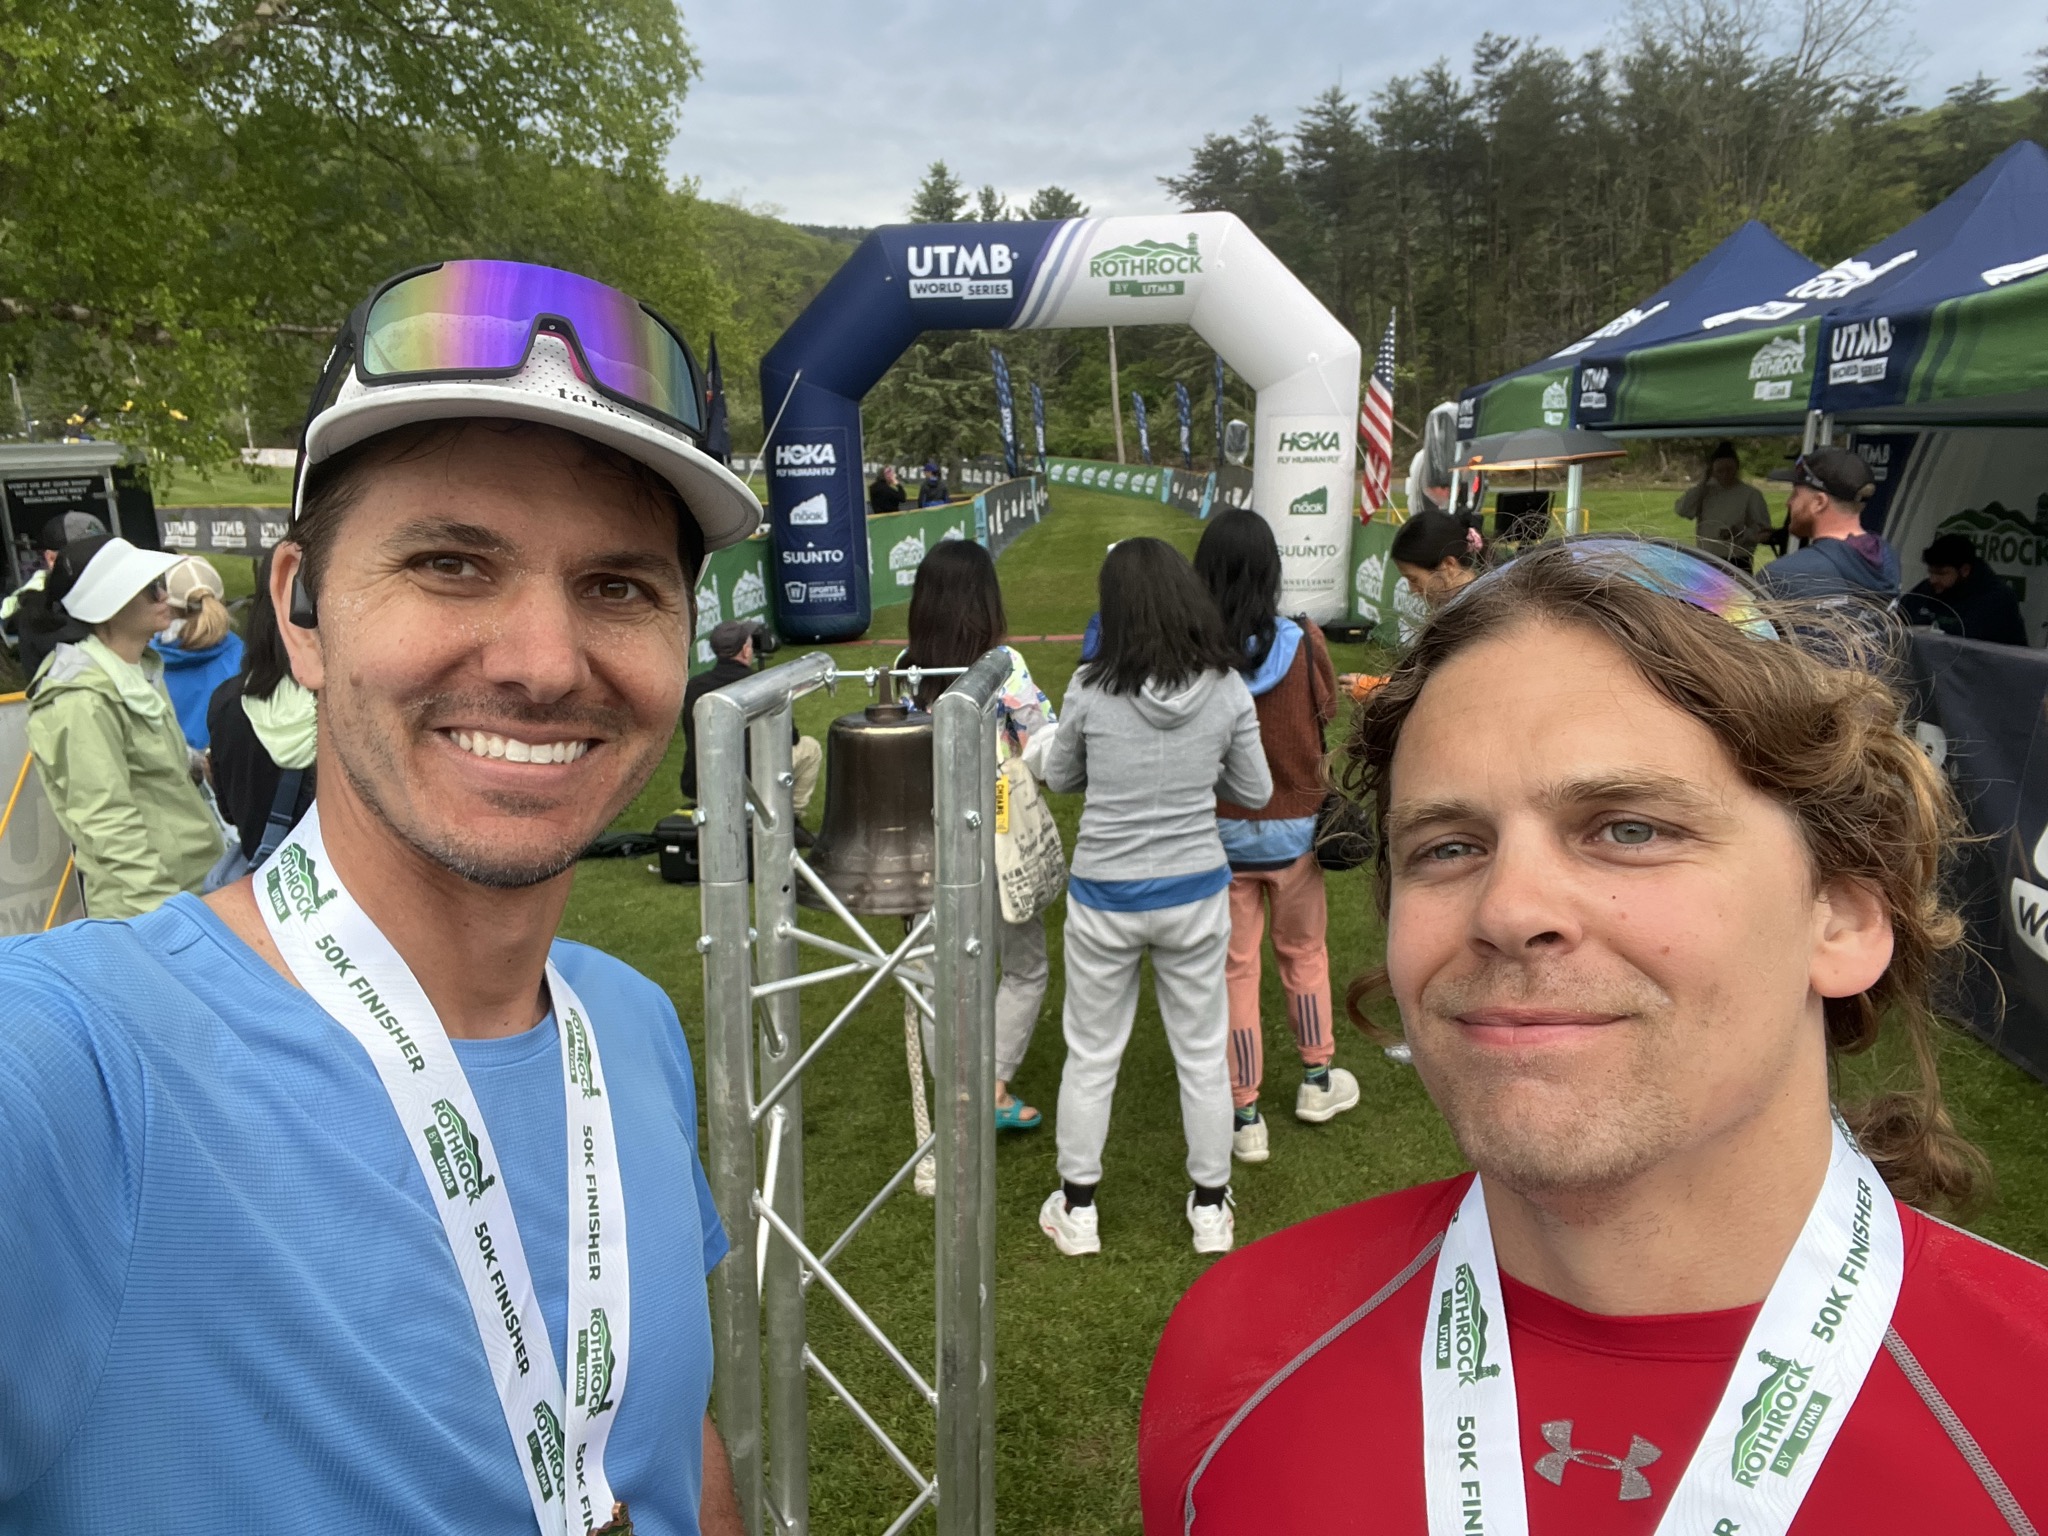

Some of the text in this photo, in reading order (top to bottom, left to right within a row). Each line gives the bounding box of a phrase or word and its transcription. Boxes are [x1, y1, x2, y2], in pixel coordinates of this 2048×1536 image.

[907, 243, 1013, 277] UTMB
[913, 282, 1010, 296] WORLD SERIES
[1089, 255, 1204, 278] ROTHROCK
[1114, 282, 1176, 295] BY UTMB
[1748, 353, 1806, 380] ROTHROCK
[1831, 317, 1893, 361] UTMB
[775, 443, 837, 466] HOKA
[1279, 432, 1341, 451] HOKA
[782, 550, 844, 564] SUUNTO
[1277, 545, 1337, 557] SUUNTO
[271, 888, 287, 915] UTMB
[280, 847, 318, 923] ROTHROCK
[315, 933, 426, 1074] 50K FINISHER
[568, 1006, 591, 1100] ROTHROCK
[428, 1130, 455, 1191] BY UTMB
[431, 1099, 481, 1206] ROTHROCK
[583, 1125, 601, 1281] 50K FINISHER
[1810, 1177, 1872, 1344] 50K FINISHER
[474, 1221, 530, 1378] 50K FINISHER
[1438, 1294, 1451, 1360] BY UTMB
[1455, 1263, 1477, 1389] ROTHROCK
[577, 1334, 587, 1397] BY UTMB
[585, 1308, 602, 1422] ROTHROCK
[1735, 1358, 1815, 1489] ROTHROCK
[1776, 1399, 1824, 1470] BY UTMB
[529, 1437, 551, 1493] BY UTMB
[575, 1443, 587, 1491] 50K
[1457, 1416, 1485, 1536] 50K FIN
